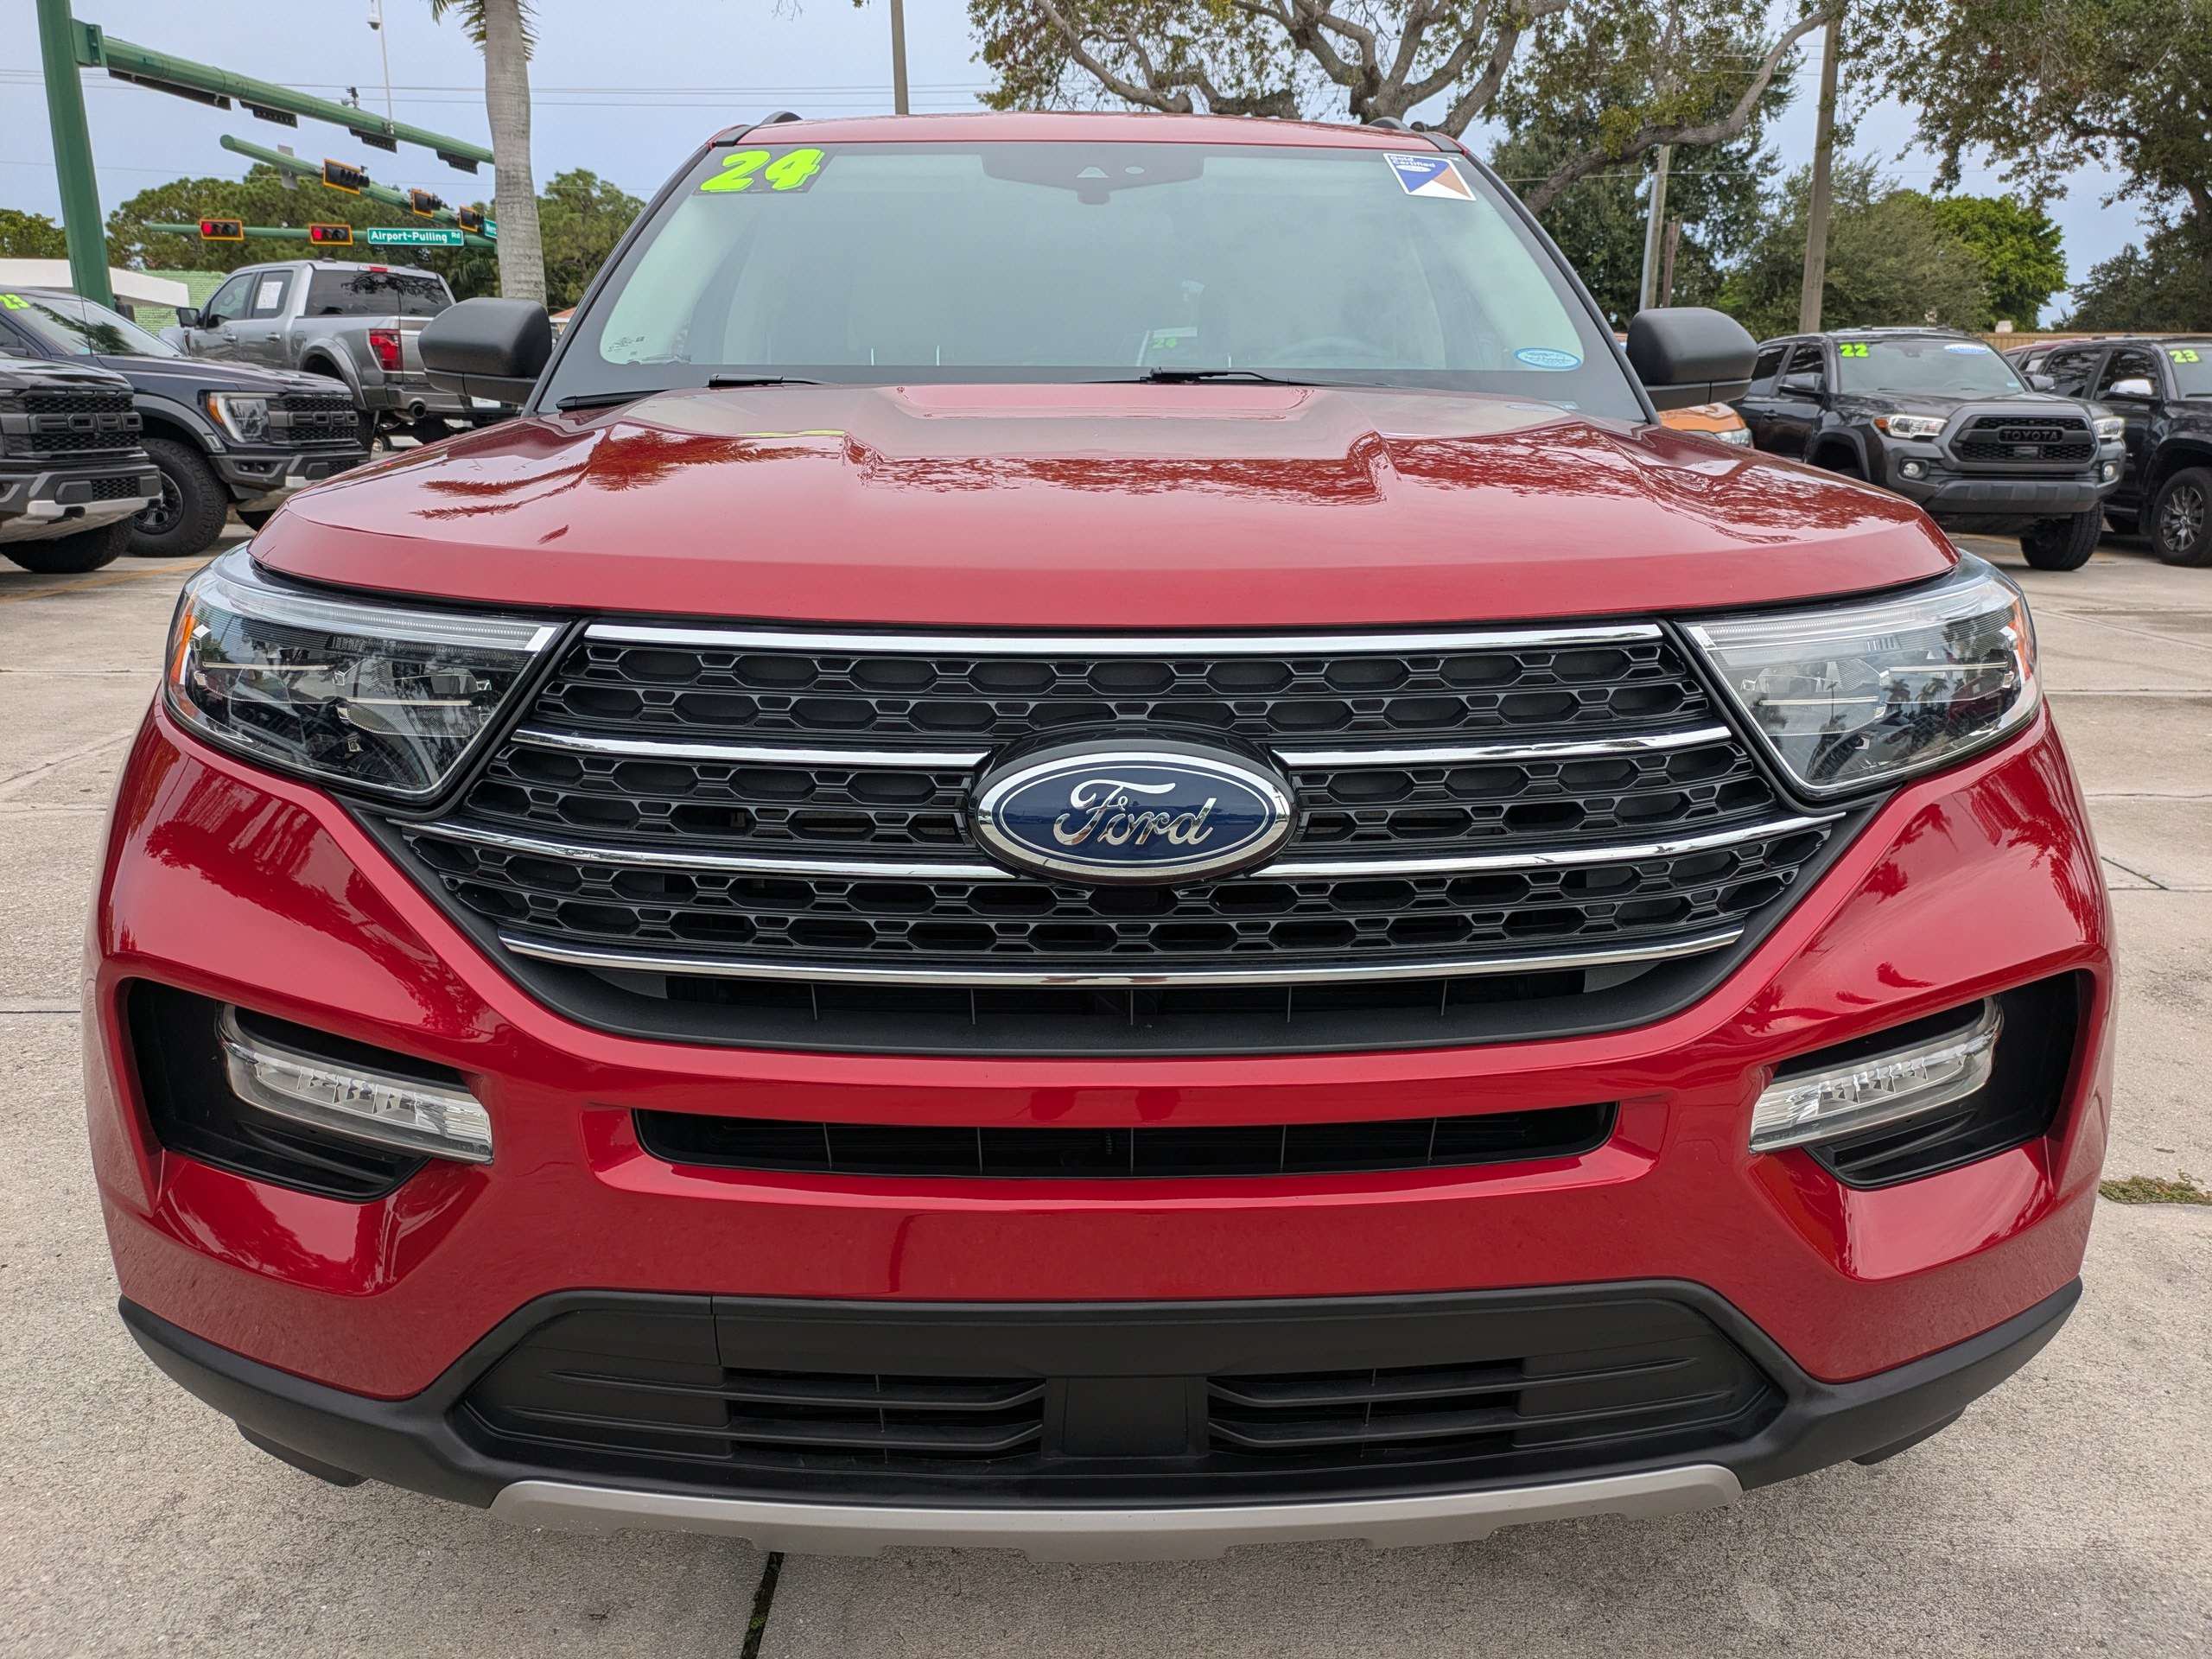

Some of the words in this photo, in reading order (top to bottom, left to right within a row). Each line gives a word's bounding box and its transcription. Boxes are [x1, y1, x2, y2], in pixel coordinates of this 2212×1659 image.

[700, 149, 825, 192] 24
[371, 231, 448, 244] Airport-Pulling
[1839, 344, 1869, 358] 22
[2169, 349, 2199, 363] 23
[2004, 430, 2057, 441] TOYOTA
[1052, 779, 1217, 846] Ford
